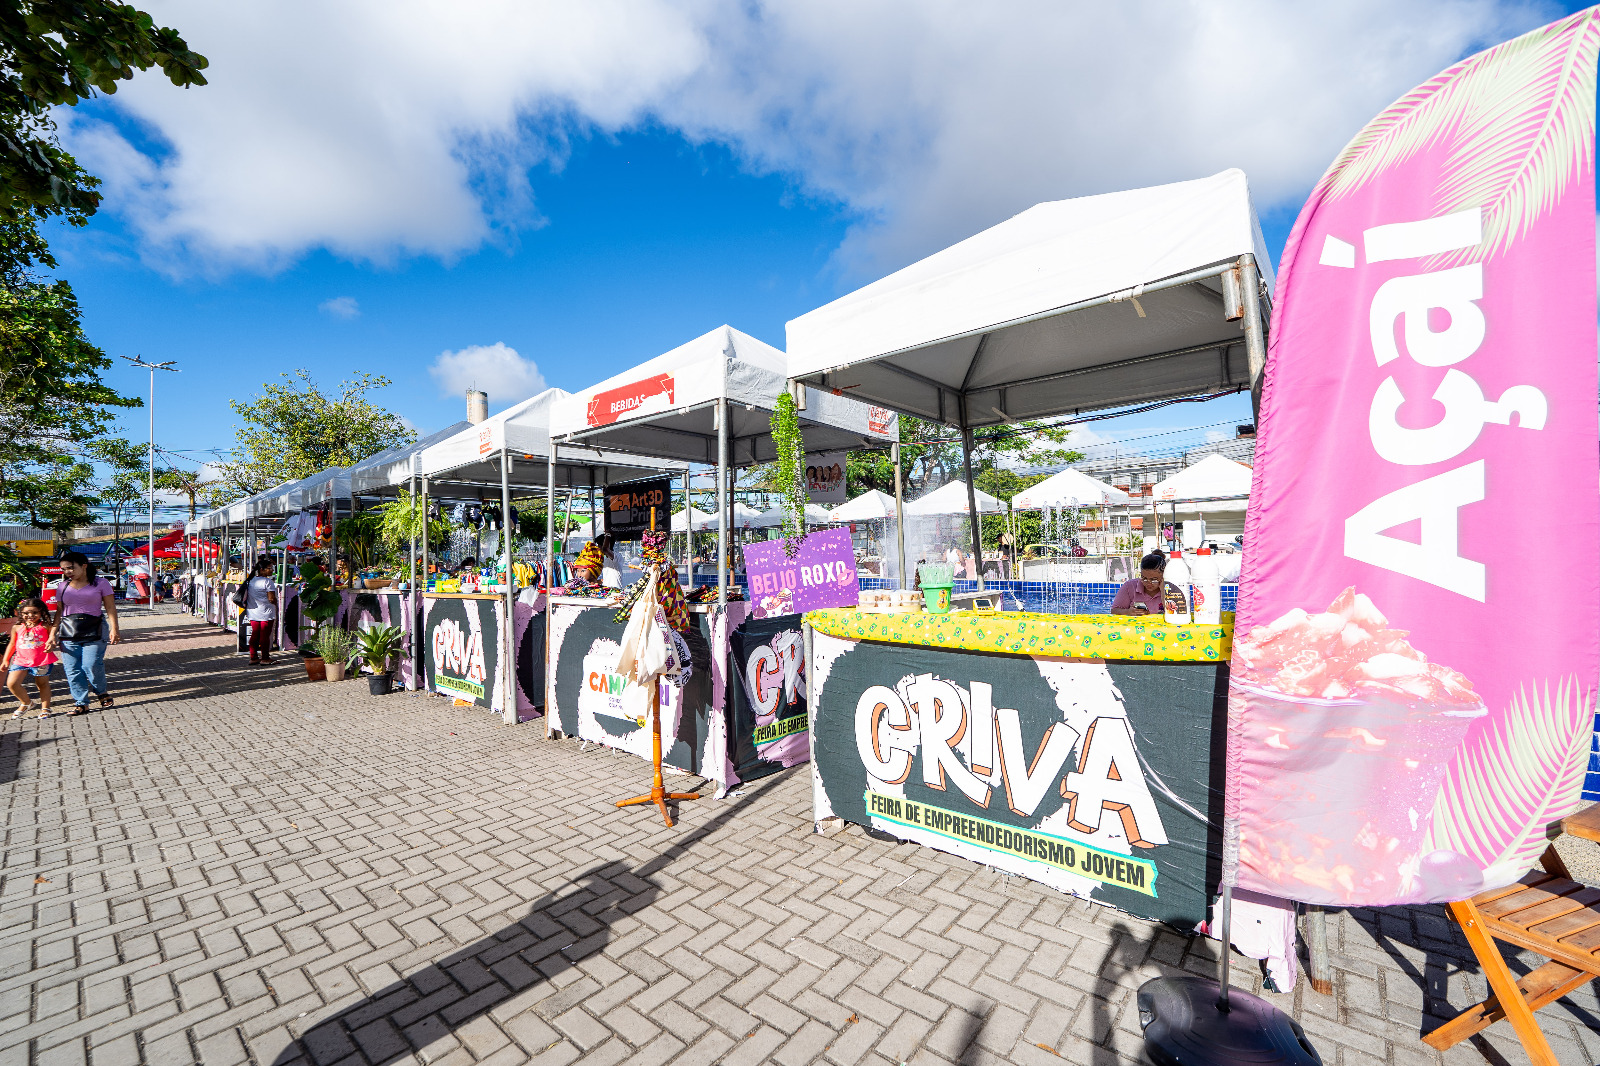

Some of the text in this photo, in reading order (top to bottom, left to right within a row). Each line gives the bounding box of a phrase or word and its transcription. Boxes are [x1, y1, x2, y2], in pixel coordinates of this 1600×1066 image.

[611, 394, 645, 413] BEBIDAS
[1319, 207, 1548, 603] Açaí
[631, 489, 663, 507] Art3D
[751, 560, 846, 595] BEIJO ROXO
[432, 618, 487, 682] CRIVA
[757, 725, 777, 741] FEIRA
[778, 721, 787, 735] DE
[855, 676, 1169, 848] CRIVA
[871, 794, 1145, 888] FEIRA DE EMPREENDEDORISMO JOVEM
